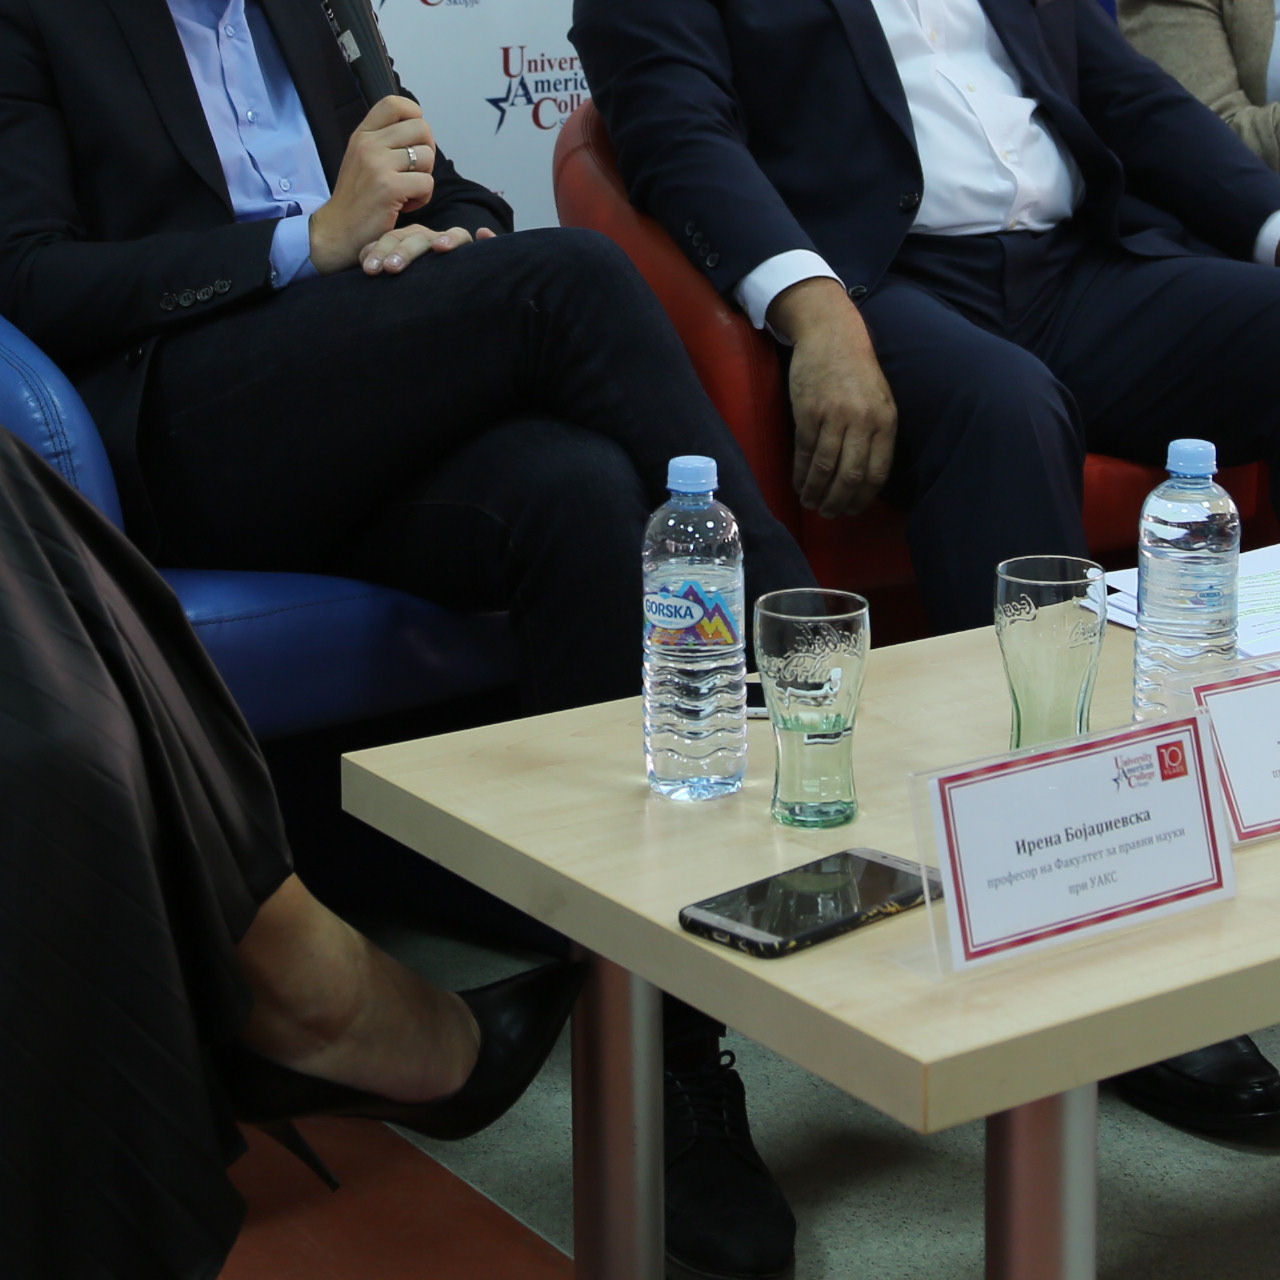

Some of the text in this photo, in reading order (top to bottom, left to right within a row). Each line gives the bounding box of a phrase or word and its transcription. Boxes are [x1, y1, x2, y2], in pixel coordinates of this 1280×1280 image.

[500, 46, 582, 78] Univer
[509, 73, 588, 107] Americ
[532, 94, 582, 130] Coll
[645, 599, 694, 619] GORSKA
[1160, 747, 1182, 768] 10
[1015, 809, 1152, 856] Ирена Бојаџиевска
[987, 827, 1186, 891] професор на Факултет за правни науки
[1068, 870, 1118, 896] при УАКС
